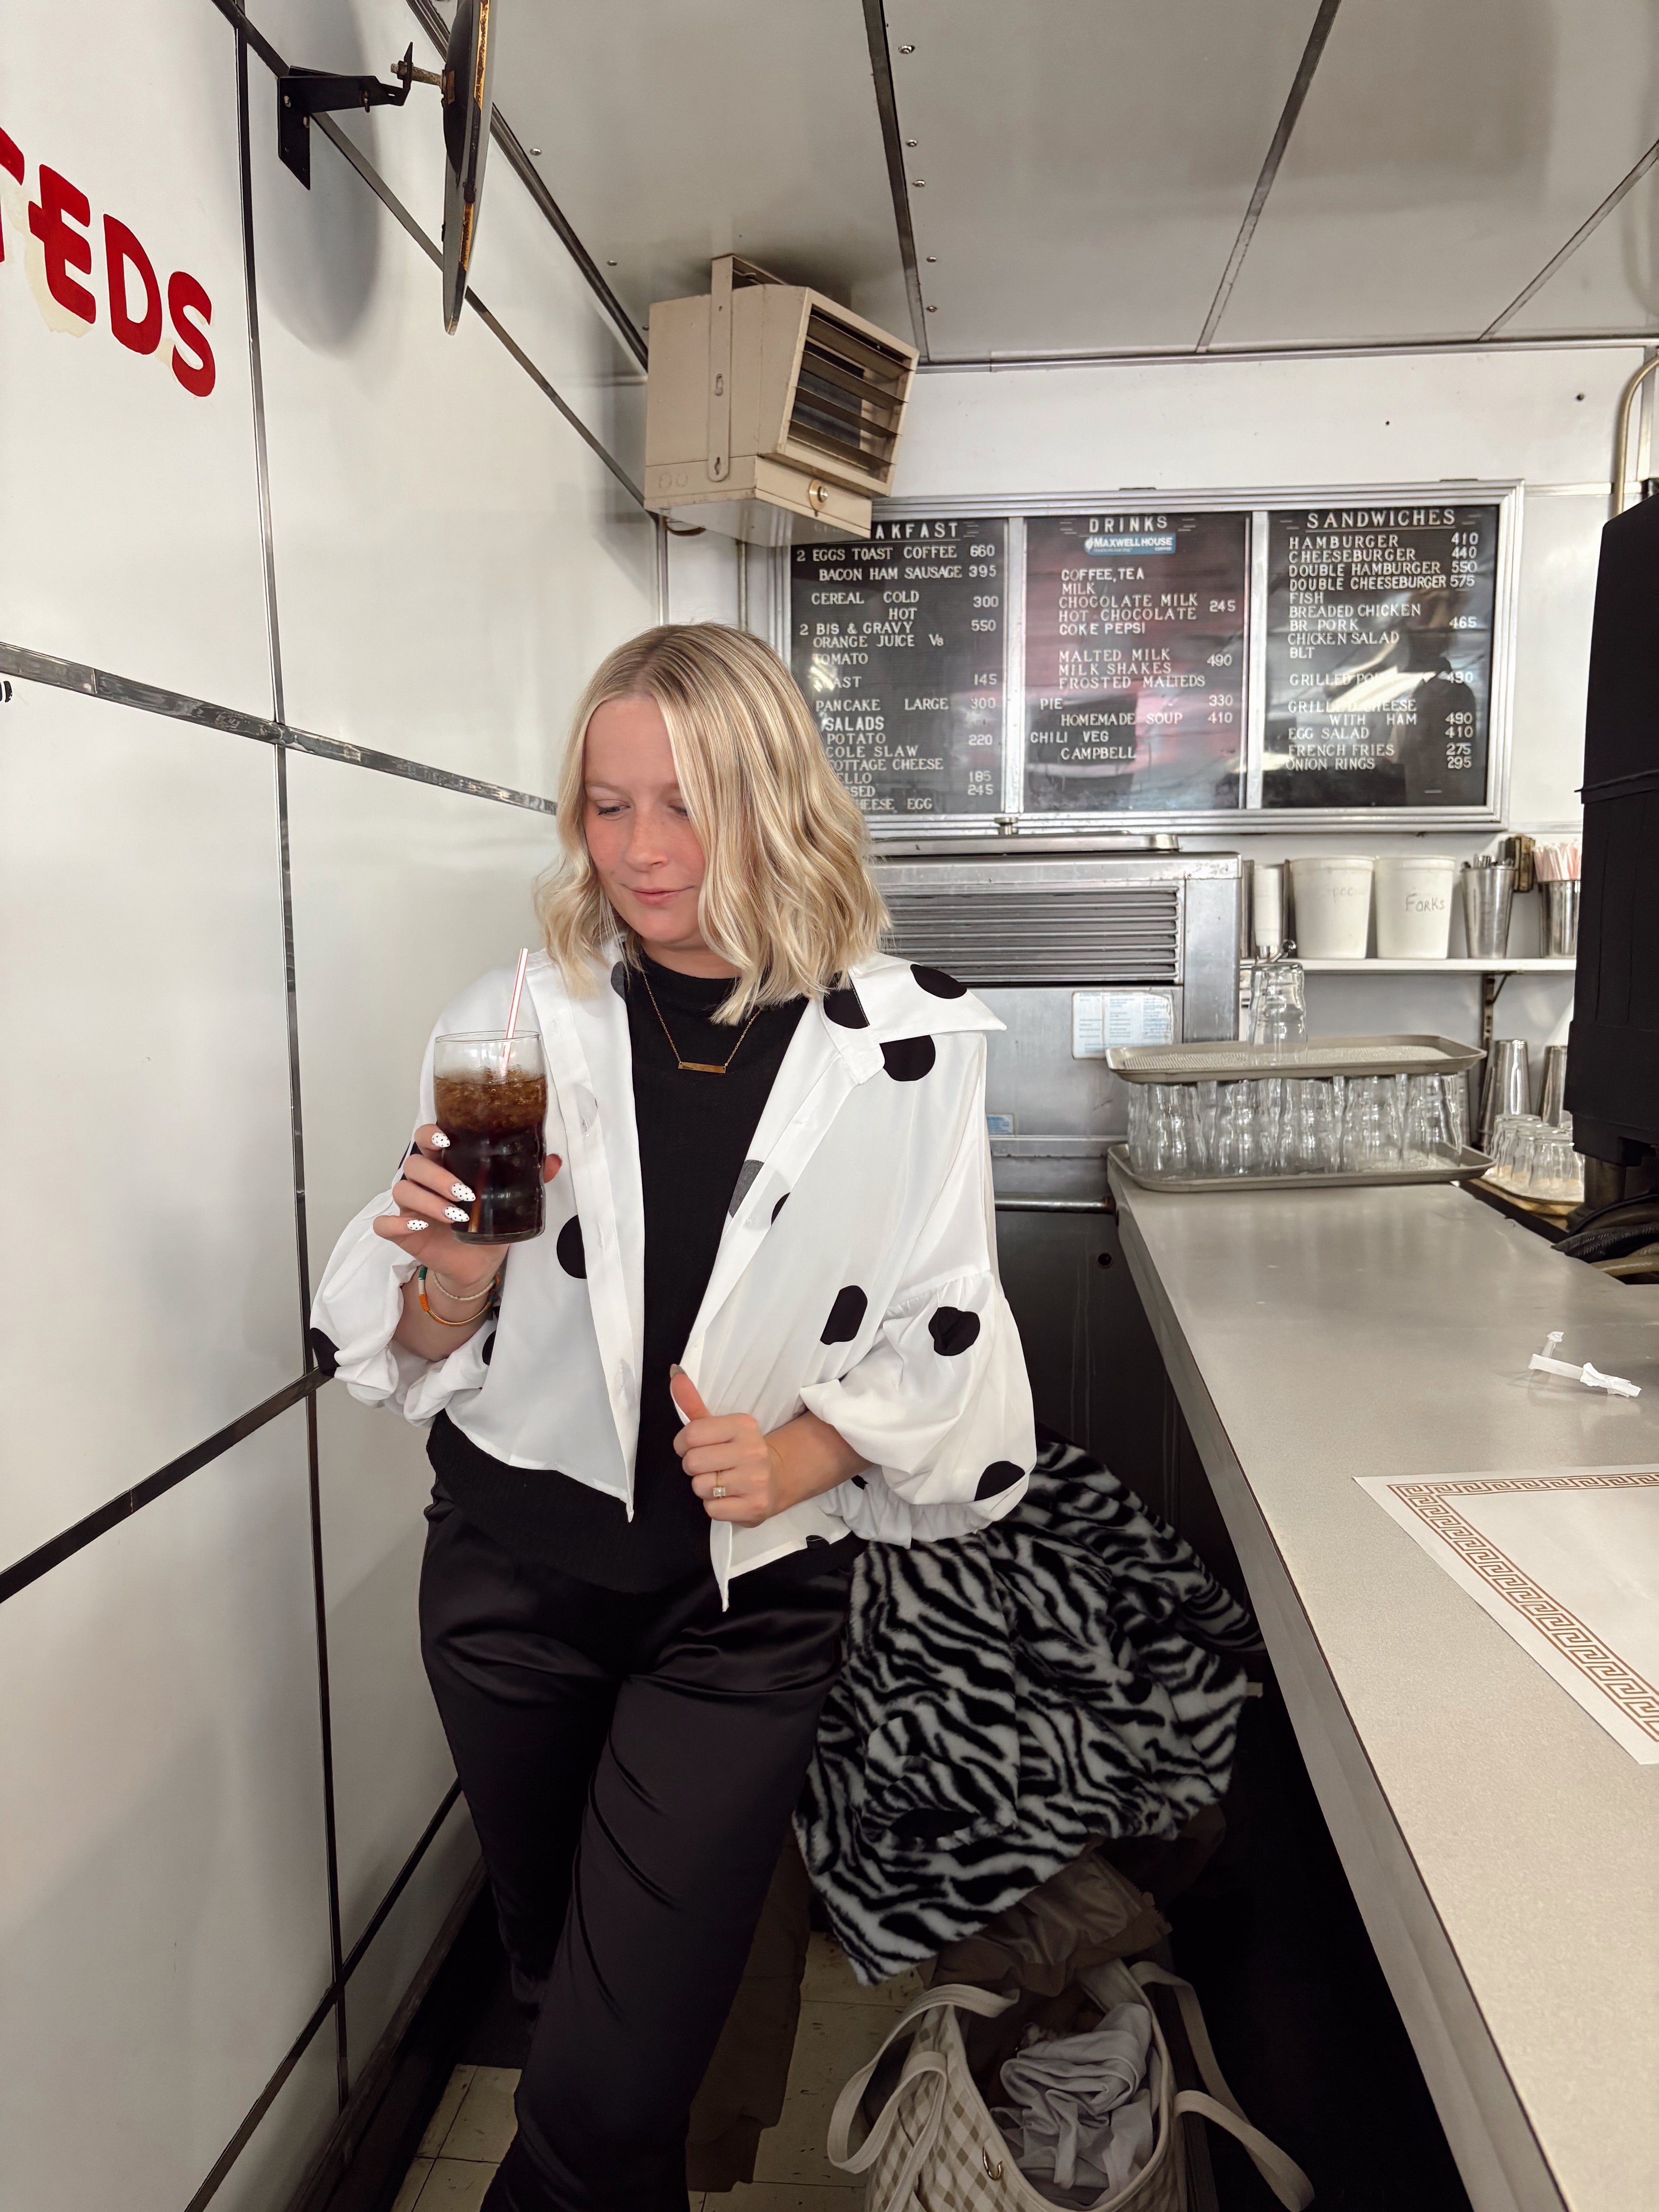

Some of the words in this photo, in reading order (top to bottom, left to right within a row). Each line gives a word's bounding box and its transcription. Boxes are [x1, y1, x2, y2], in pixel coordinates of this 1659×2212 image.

[0, 127, 215, 396] EDS
[1089, 516, 1167, 533] DRINKS
[1307, 509, 1455, 529] SANDWICHES
[876, 522, 957, 539] AKFAST
[1094, 538, 1140, 548] MAXWELL
[1141, 538, 1173, 546] HOUSE
[1289, 534, 1398, 550] HAMBURGER
[1451, 532, 1478, 545] 410
[797, 550, 805, 562] 2
[813, 549, 845, 561] EGGS
[852, 547, 893, 560] TOAST
[903, 545, 957, 559] COFFEE
[970, 545, 995, 557] 660
[1289, 548, 1416, 563] CHEESEBURGER
[1452, 547, 1477, 559] 440
[819, 568, 862, 581] BACON
[870, 568, 898, 580] HAM
[905, 566, 962, 579] SAUSAGE
[969, 565, 996, 578] 395
[1289, 563, 1344, 577] DOUBLE
[1351, 561, 1440, 576] HAMBURGER
[1452, 562, 1477, 573] 550
[1062, 583, 1095, 594] MILK
[1290, 578, 1344, 591] DOUBLE
[1351, 575, 1446, 590] CHEESEBURGER
[1450, 575, 1475, 587] 575
[811, 591, 864, 604] CEREAL
[883, 591, 919, 604] COLD
[973, 596, 998, 608] 300
[1059, 595, 1151, 608] CHOCOLATE
[1161, 593, 1198, 607] MILK
[1289, 592, 1324, 604] FISH
[1210, 600, 1236, 612] 245
[1289, 605, 1354, 619] BREADED
[1358, 604, 1421, 617] CHICKEN
[889, 608, 917, 620] HOT
[1059, 610, 1088, 622] HOT
[1100, 607, 1197, 621] CHOCOLATE
[800, 624, 808, 635] 2
[816, 624, 839, 635] BIS
[847, 623, 858, 634] &
[863, 621, 913, 634] GRAVY
[971, 620, 996, 632] 550
[1059, 623, 1099, 636] COKE
[1105, 622, 1145, 634] PEPSI
[1290, 619, 1307, 632] BR
[1318, 618, 1359, 631] PORK
[1449, 617, 1477, 629] 465
[813, 636, 868, 648] ORANGE
[876, 635, 915, 647] JUICE
[929, 634, 944, 646] V8
[1288, 632, 1347, 645] CHICKEN
[1351, 631, 1400, 644] SALAD
[813, 653, 868, 664] TOMATO
[1059, 650, 1121, 663] MALTED
[1132, 648, 1171, 661] MILK
[1207, 654, 1232, 666] 490
[1290, 646, 1315, 659] BLT
[1059, 664, 1099, 676] MILK
[1107, 662, 1171, 675] SHAKES
[975, 674, 997, 685] 145
[1059, 677, 1131, 689] FROSTED
[1143, 674, 1205, 688] MALTEDS
[1449, 672, 1473, 683] 490
[816, 699, 880, 712] PANCAKE
[904, 698, 949, 710] LARGE
[971, 698, 995, 709] 300
[1040, 698, 1063, 710] PIE
[1209, 695, 1233, 706] 330
[824, 717, 884, 731] SALADS
[1061, 713, 1135, 726] HOMEMADE
[1146, 712, 1182, 725] SOUP
[1208, 712, 1233, 724] 410
[1330, 714, 1365, 726] WITH
[1386, 713, 1417, 725] HAM
[1445, 712, 1472, 725] 490
[827, 733, 886, 745] POTATO
[969, 735, 992, 745] 220
[1030, 731, 1068, 744] CHILI
[1083, 731, 1109, 742] VEG
[1288, 728, 1313, 740] EGG
[1322, 727, 1370, 740] SALAD
[1445, 726, 1473, 738] 410
[826, 746, 865, 758] COLE
[874, 745, 918, 757] SLAW
[1061, 747, 1135, 760] CAMPBELL
[1288, 745, 1345, 756] FRENCH
[1352, 744, 1395, 756] FRIES
[1446, 742, 1471, 755] 275
[893, 758, 944, 770] CHEESE
[1286, 759, 1327, 771] ONION
[1335, 757, 1376, 770] RINGS
[1447, 756, 1472, 769] 295
[838, 772, 872, 784] ELLO
[969, 772, 991, 782] 185
[967, 785, 993, 795] 245
[907, 798, 933, 810] EGG
